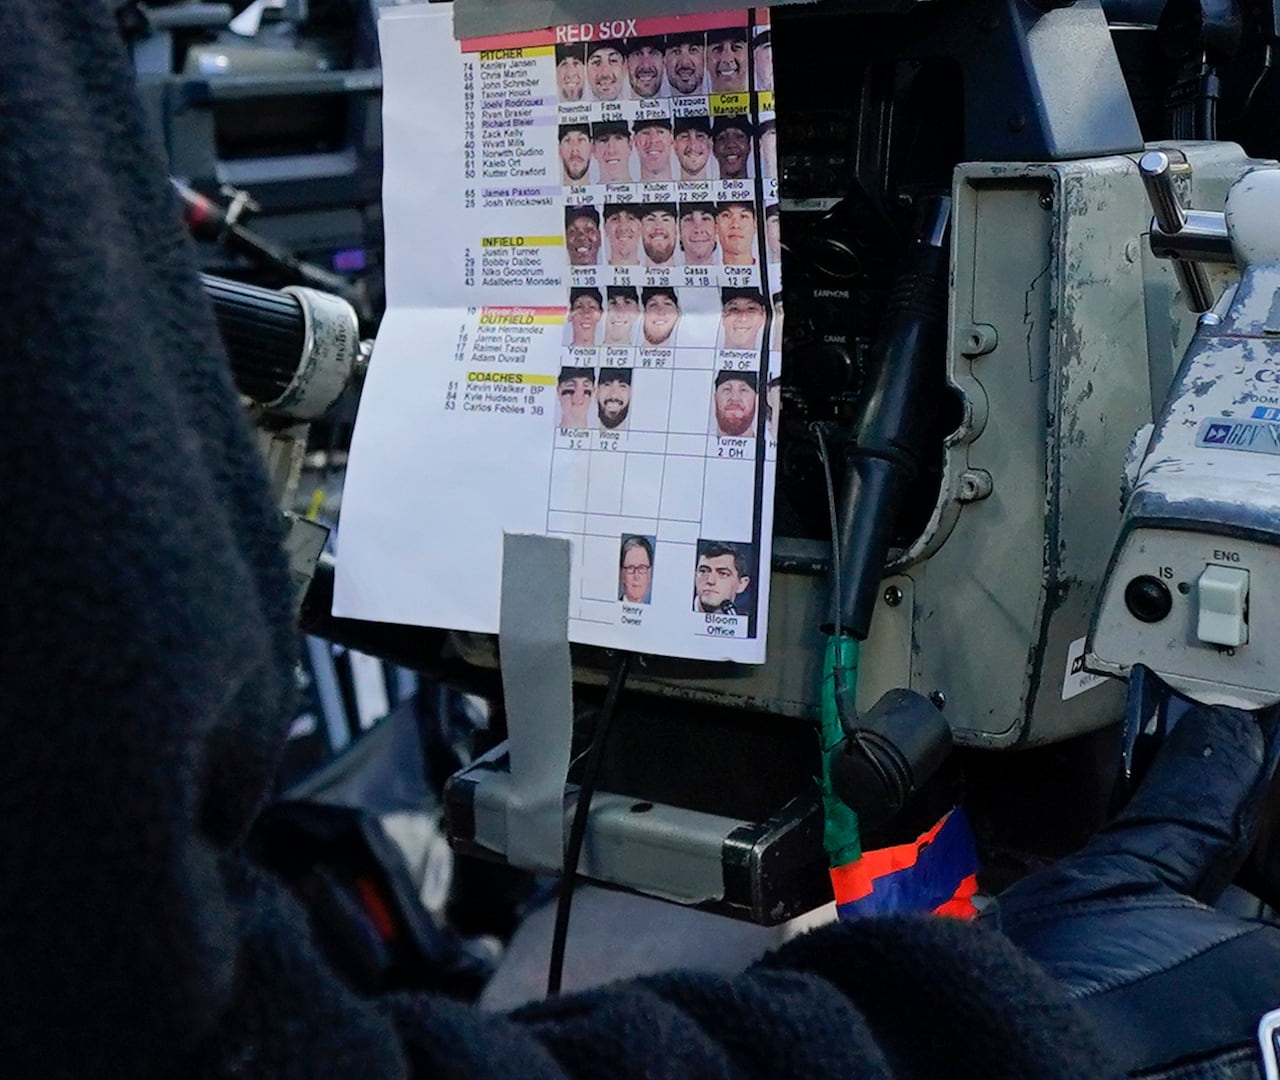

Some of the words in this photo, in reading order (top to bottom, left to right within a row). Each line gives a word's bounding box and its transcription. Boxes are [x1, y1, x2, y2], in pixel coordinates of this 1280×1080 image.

[556, 23, 594, 42] RED
[599, 19, 638, 39] SOX
[480, 48, 524, 61] PITCHER
[480, 71, 501, 80] Chris
[481, 82, 501, 90] John
[481, 91, 507, 99] Tanner
[720, 94, 739, 104] Cora
[482, 110, 502, 119] Ryan
[713, 105, 748, 115] Manager
[482, 189, 510, 197] James
[483, 199, 503, 208] Josh
[482, 236, 524, 247] INFIELD
[482, 248, 509, 257] Justin
[511, 247, 539, 256] Turner
[482, 258, 510, 267] Bobby
[512, 257, 541, 266] Dalbec
[503, 267, 544, 276] Goodrum
[645, 267, 670, 276] Arroyo
[684, 266, 708, 275] Casas
[482, 278, 524, 286] Adalberto
[526, 277, 562, 286] Mondesi
[480, 314, 535, 324] OUTFIELD
[504, 334, 531, 343] Duran
[498, 354, 526, 363] Duvall
[738, 361, 751, 370] OF
[468, 372, 523, 384] COACHES
[466, 383, 491, 392] Kevin
[494, 384, 525, 394] Walker
[530, 386, 544, 395] BP
[464, 393, 483, 401] Kyle
[485, 394, 518, 403] Hudson
[524, 396, 535, 404] 1B
[463, 402, 492, 412] Carlos
[495, 404, 525, 414] Febles
[531, 406, 544, 415] 3B
[717, 436, 748, 447] Turner
[729, 448, 744, 458] DH
[1213, 550, 1240, 563] ENG
[1158, 567, 1174, 579] IS
[622, 604, 643, 615] Henry
[705, 613, 738, 625] Bloom
[707, 625, 736, 636] Office
